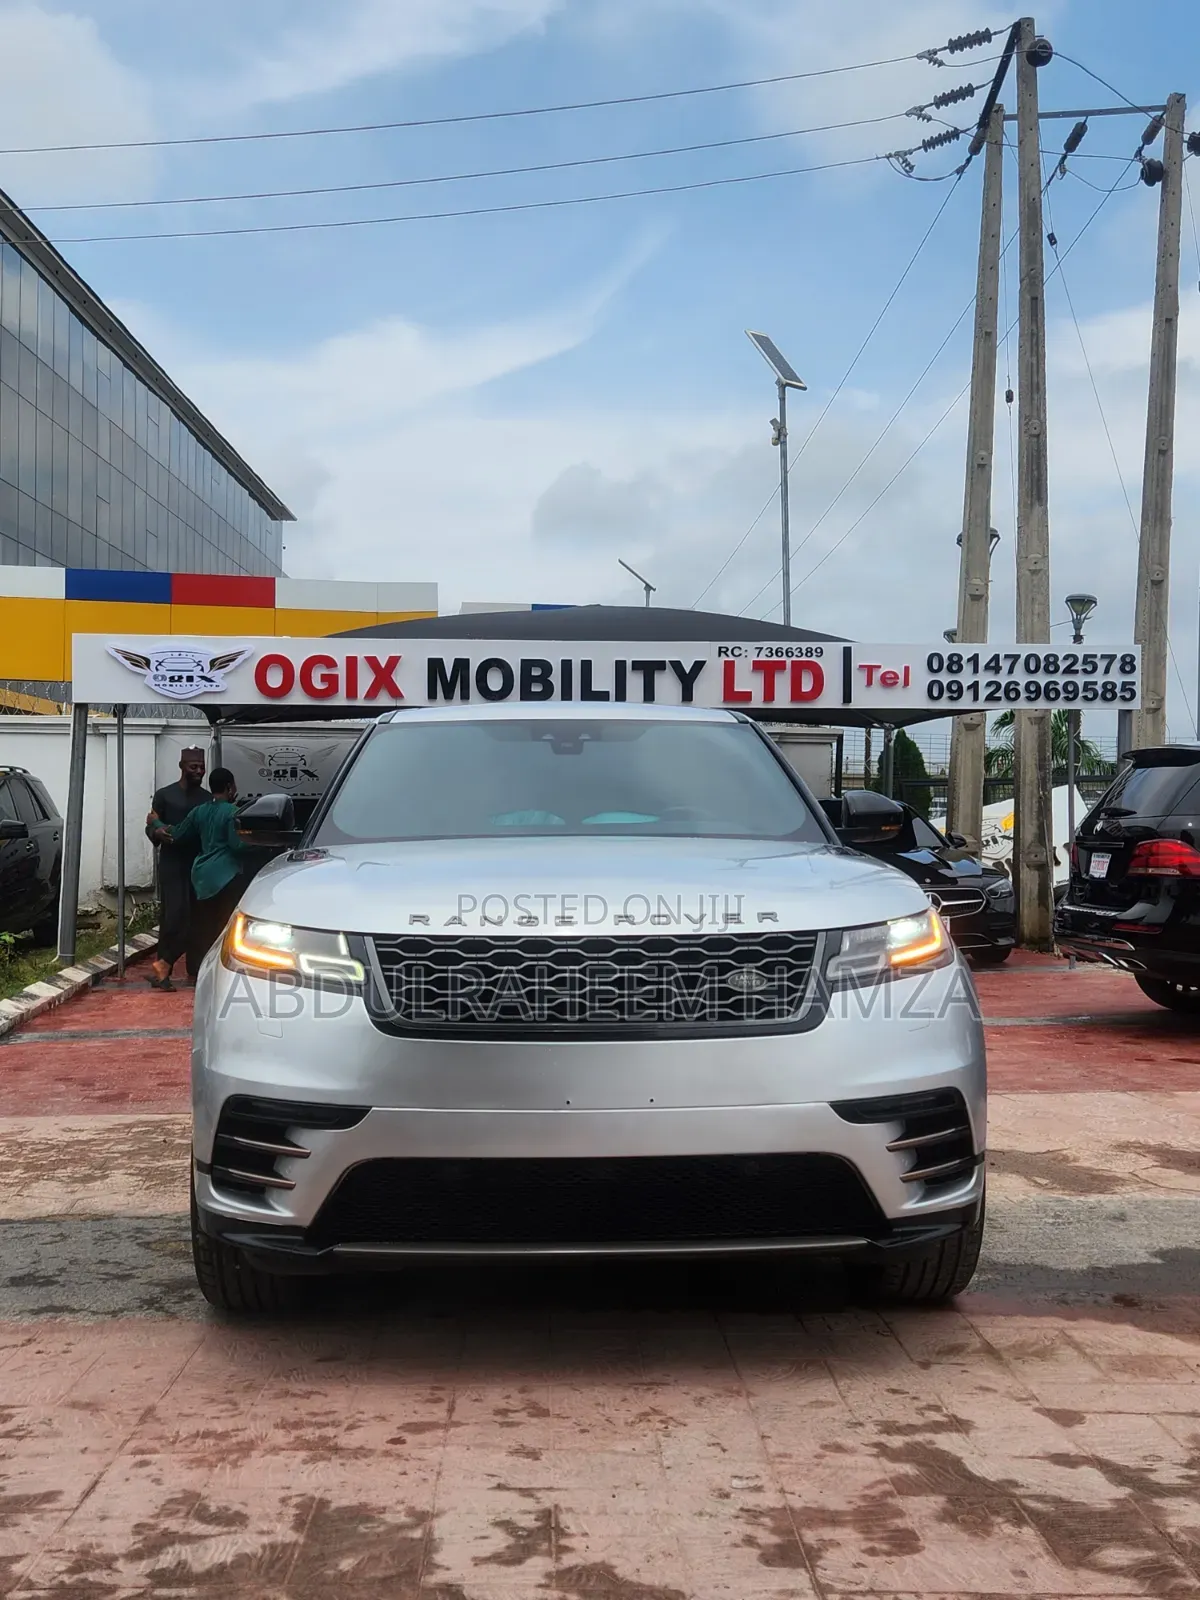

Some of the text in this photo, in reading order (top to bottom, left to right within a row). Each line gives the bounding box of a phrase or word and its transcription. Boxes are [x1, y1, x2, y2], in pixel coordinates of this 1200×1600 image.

[717, 645, 824, 658] RC: 7366389
[926, 652, 1137, 675] 08147082578
[254, 654, 826, 704] OGIX MOBILITY LTD
[859, 664, 910, 687] Tel
[926, 679, 1137, 703] 09126969585
[408, 911, 779, 926] RANGE ROVER
